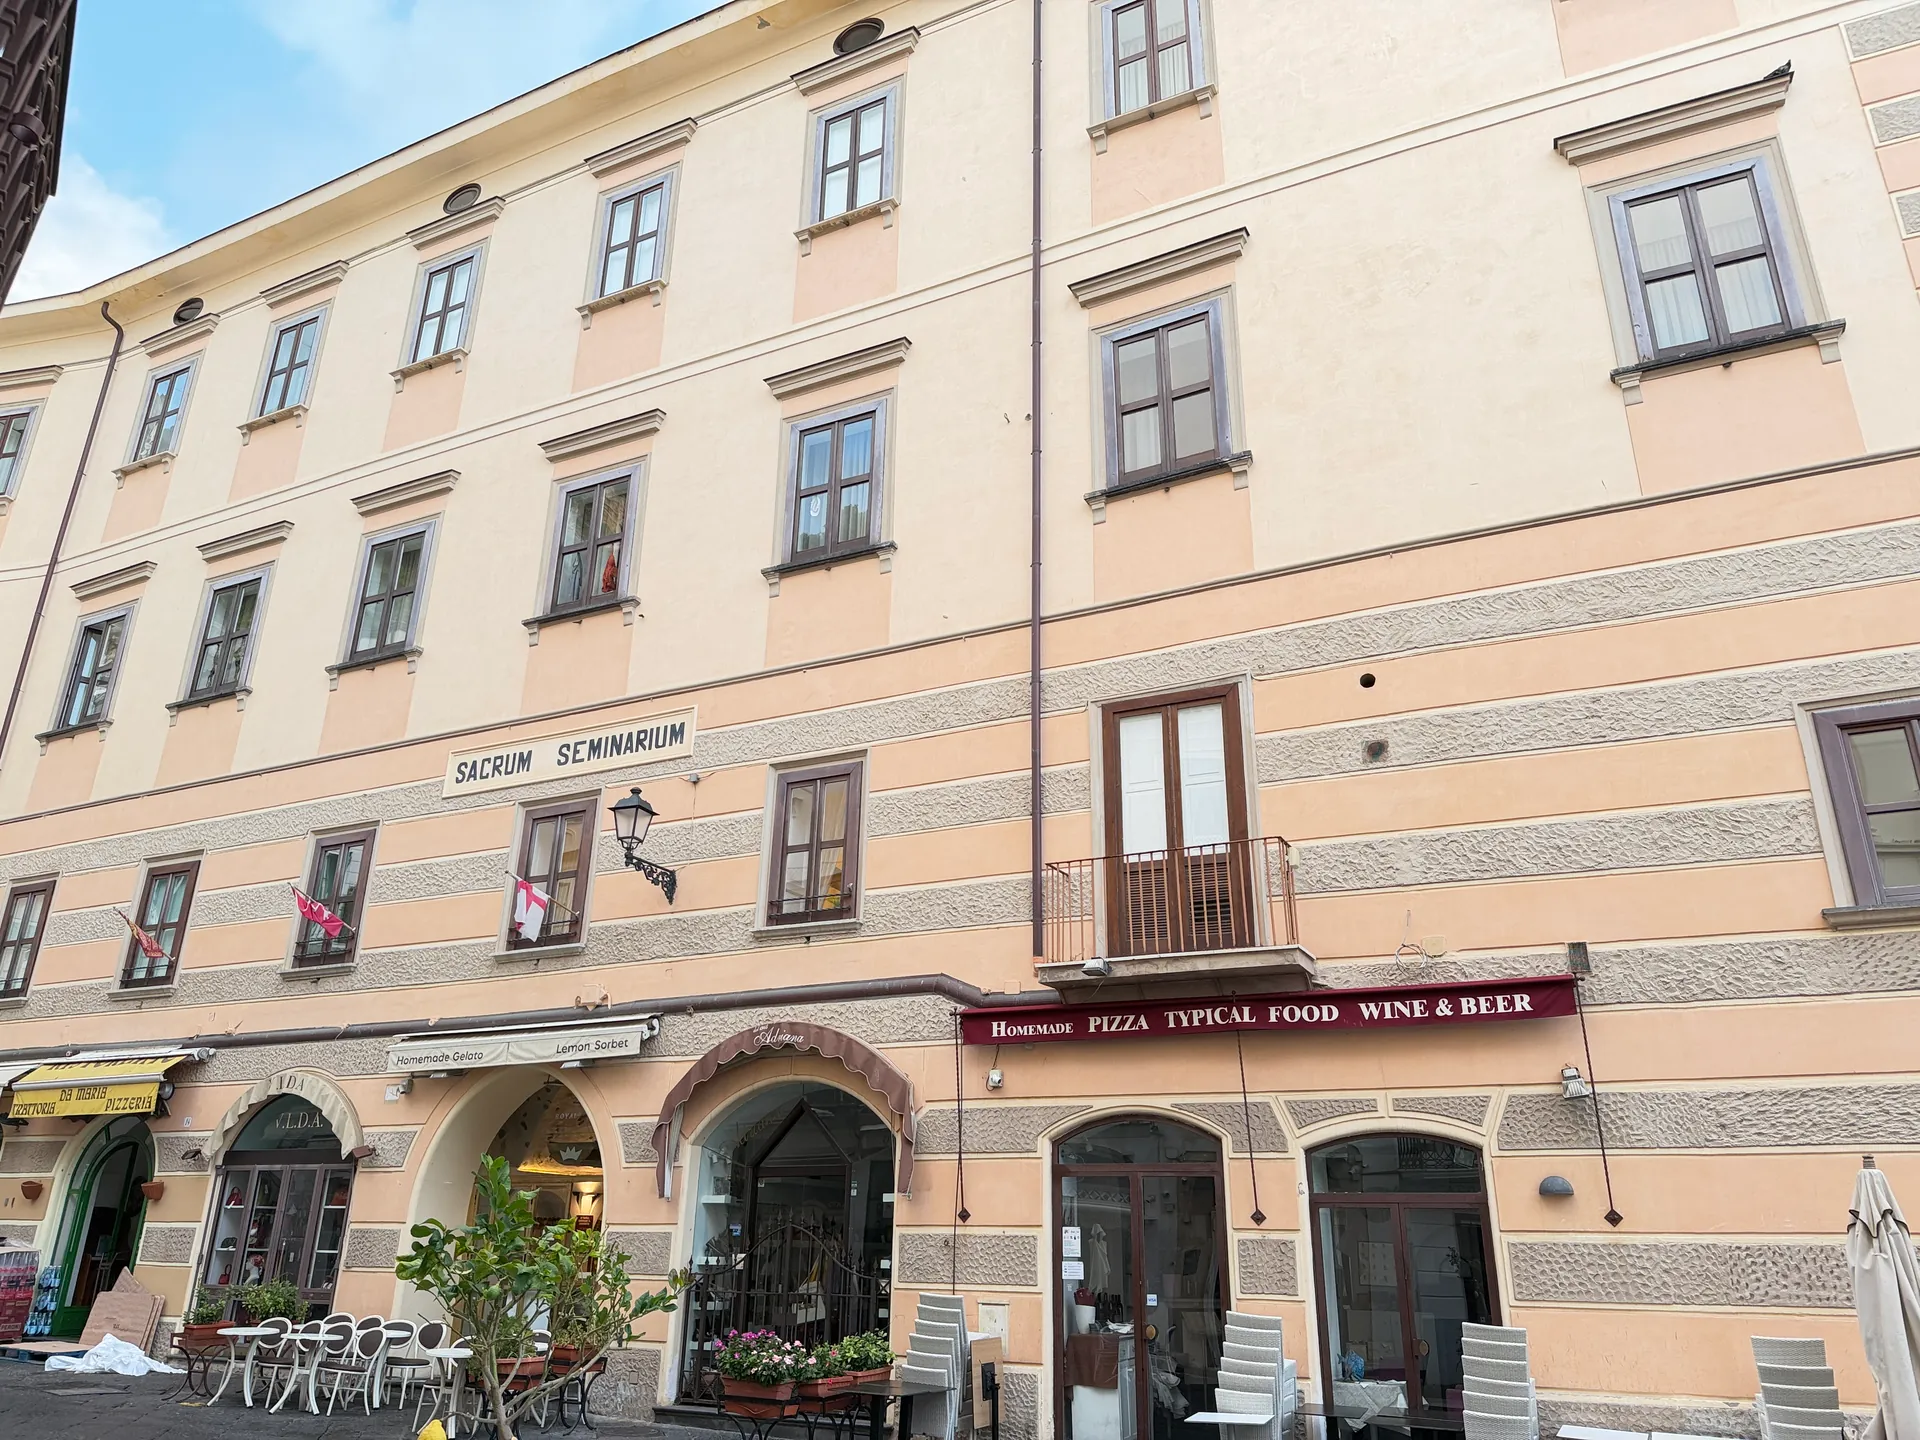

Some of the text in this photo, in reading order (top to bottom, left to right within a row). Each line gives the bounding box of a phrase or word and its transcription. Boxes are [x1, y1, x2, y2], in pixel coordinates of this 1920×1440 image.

[455, 721, 686, 784] SACRUM SEMINARIUM
[1088, 1014, 1149, 1033] PIZZA
[1164, 1006, 1256, 1028] TYPICAL
[1268, 1004, 1340, 1023] FOOD
[1358, 999, 1429, 1021] WINE
[1434, 998, 1455, 1017] &
[1459, 993, 1534, 1016] BEER
[753, 1026, 804, 1046] Adriana
[396, 1038, 629, 1066] Homemade Gelato Lemon Sorbet
[13, 1095, 153, 1116] TRATTORIA PIZZERIA
[59, 1086, 108, 1102] DA MARIA
